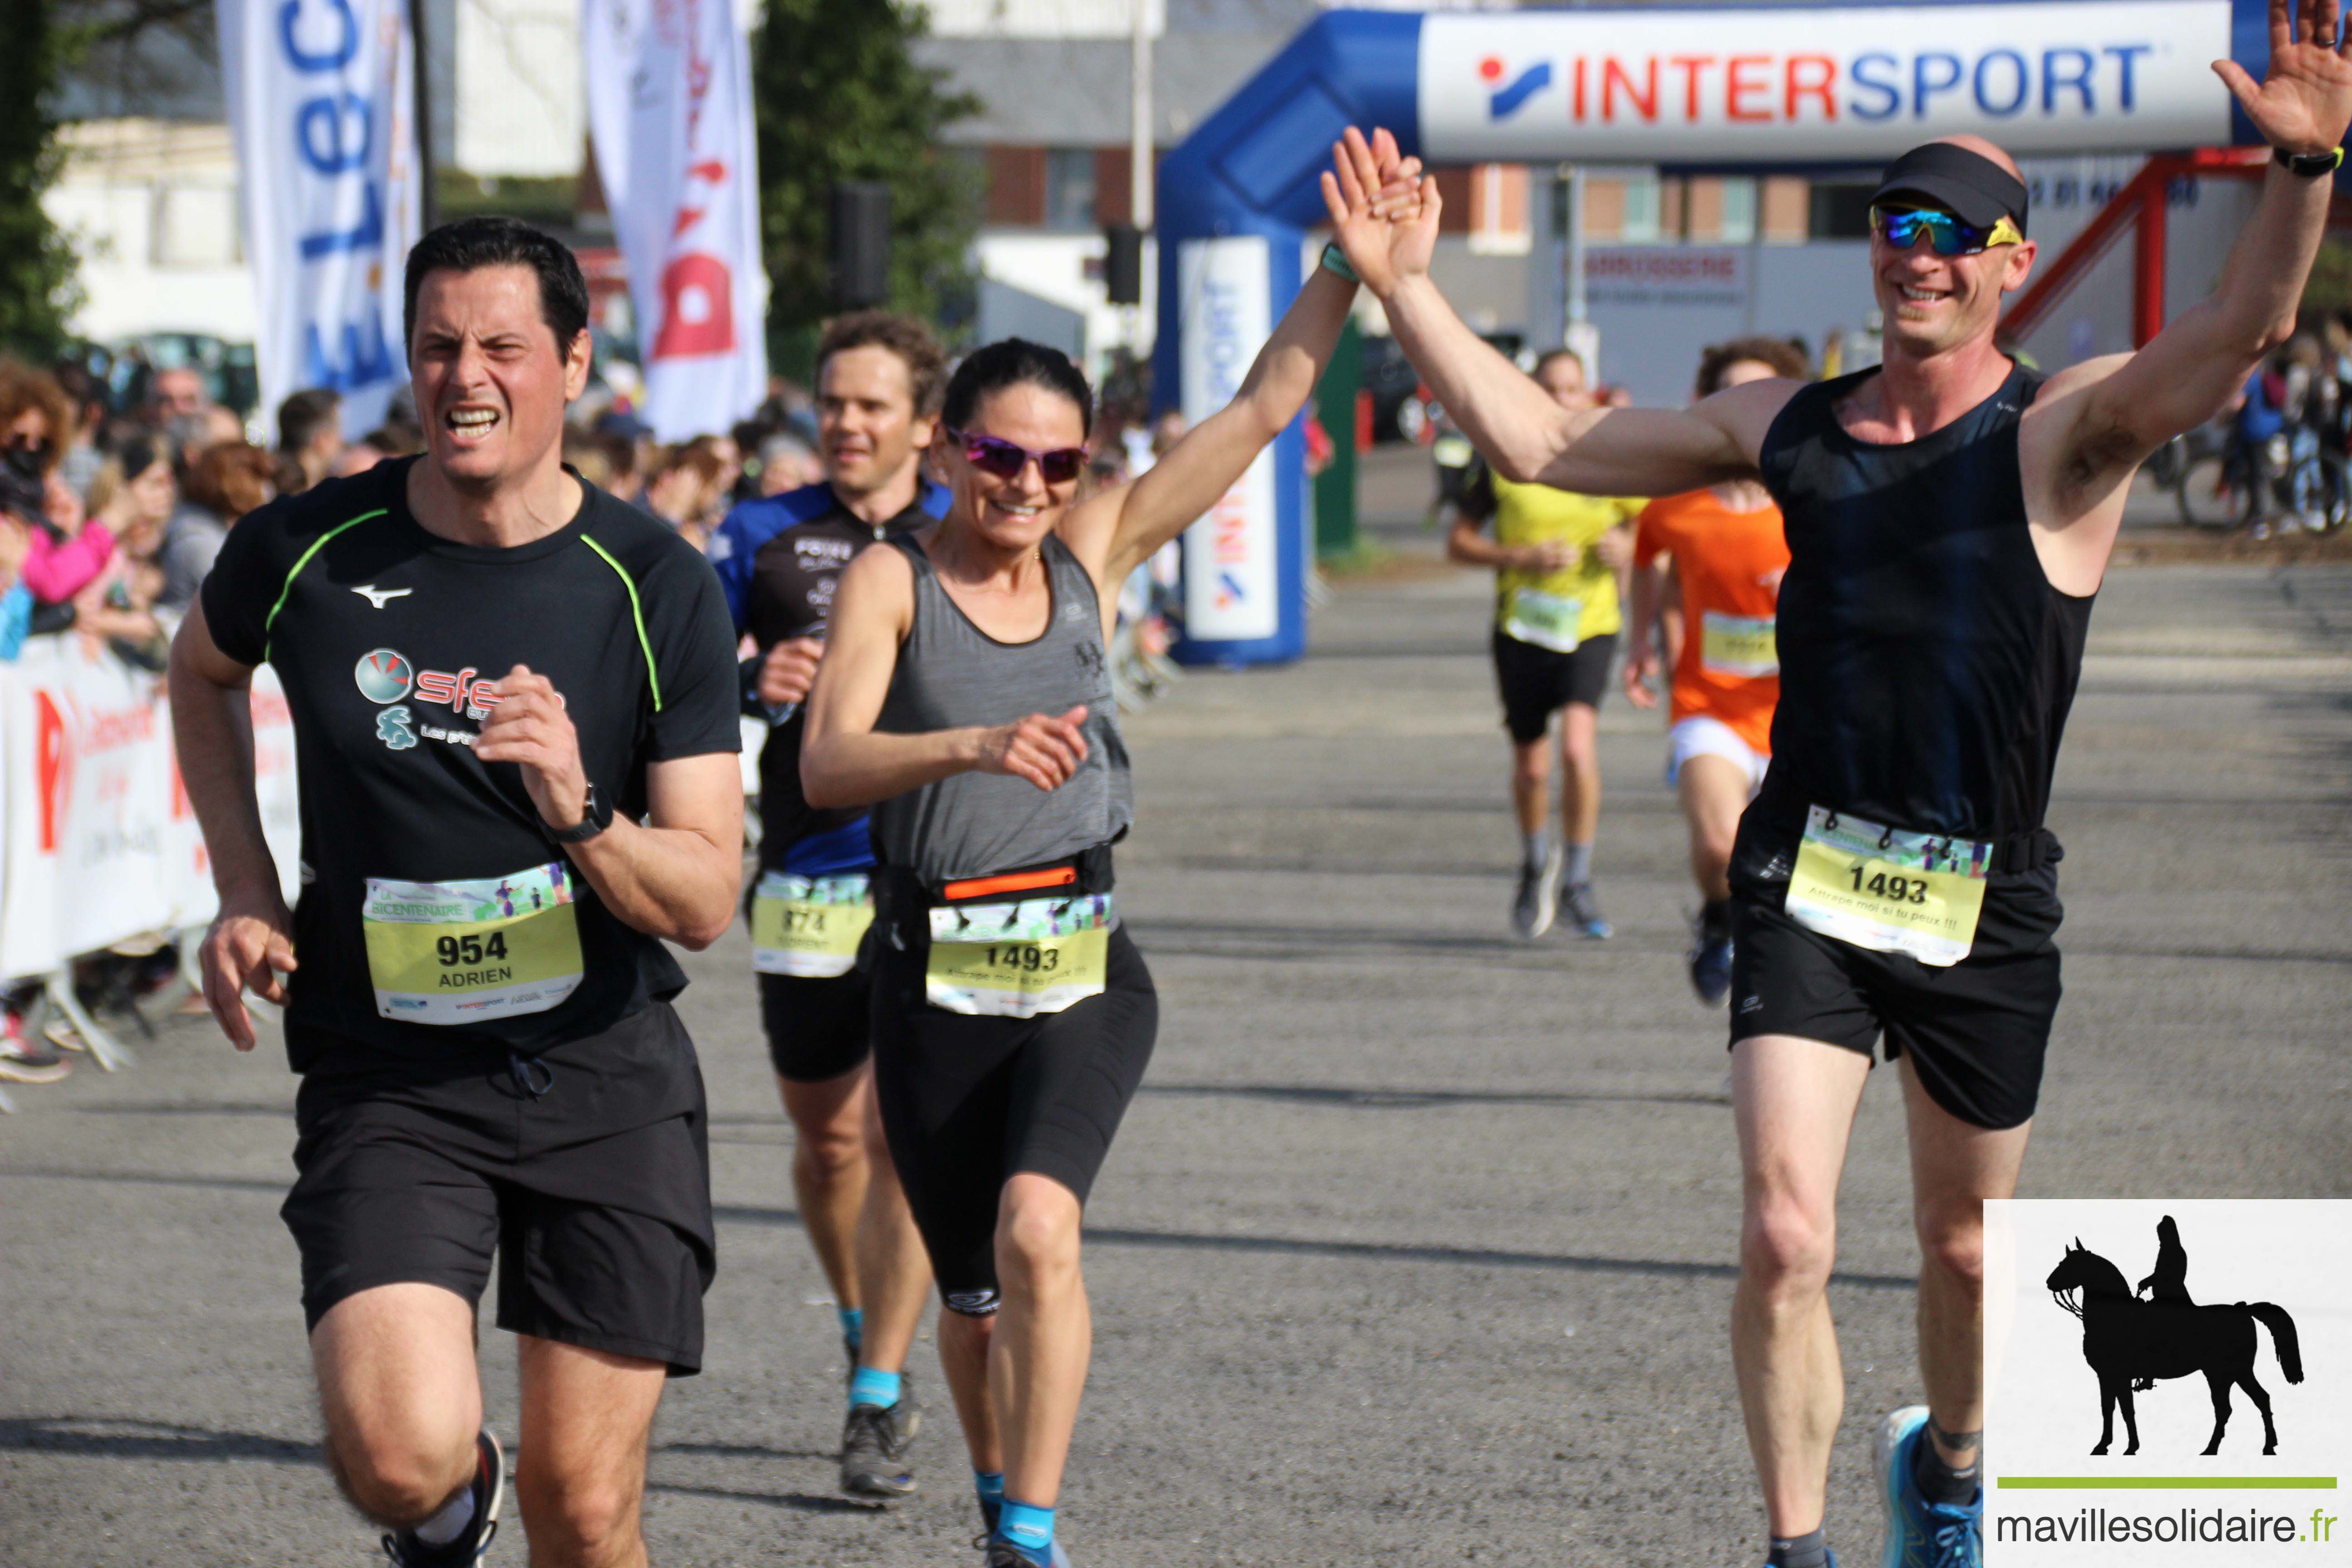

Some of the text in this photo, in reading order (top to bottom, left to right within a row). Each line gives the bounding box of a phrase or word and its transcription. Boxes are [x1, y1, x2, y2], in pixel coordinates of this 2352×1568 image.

[1572, 44, 2151, 122] INTERSPORT
[421, 723, 447, 740] Les
[1851, 866, 1929, 905] 1493
[372, 901, 464, 917] BICENTENAIRE
[1808, 887, 1958, 931] Attrape moi si tu peux !!!
[436, 931, 508, 967] 954
[987, 946, 1059, 973] 1493
[438, 967, 512, 988] ADRIEN
